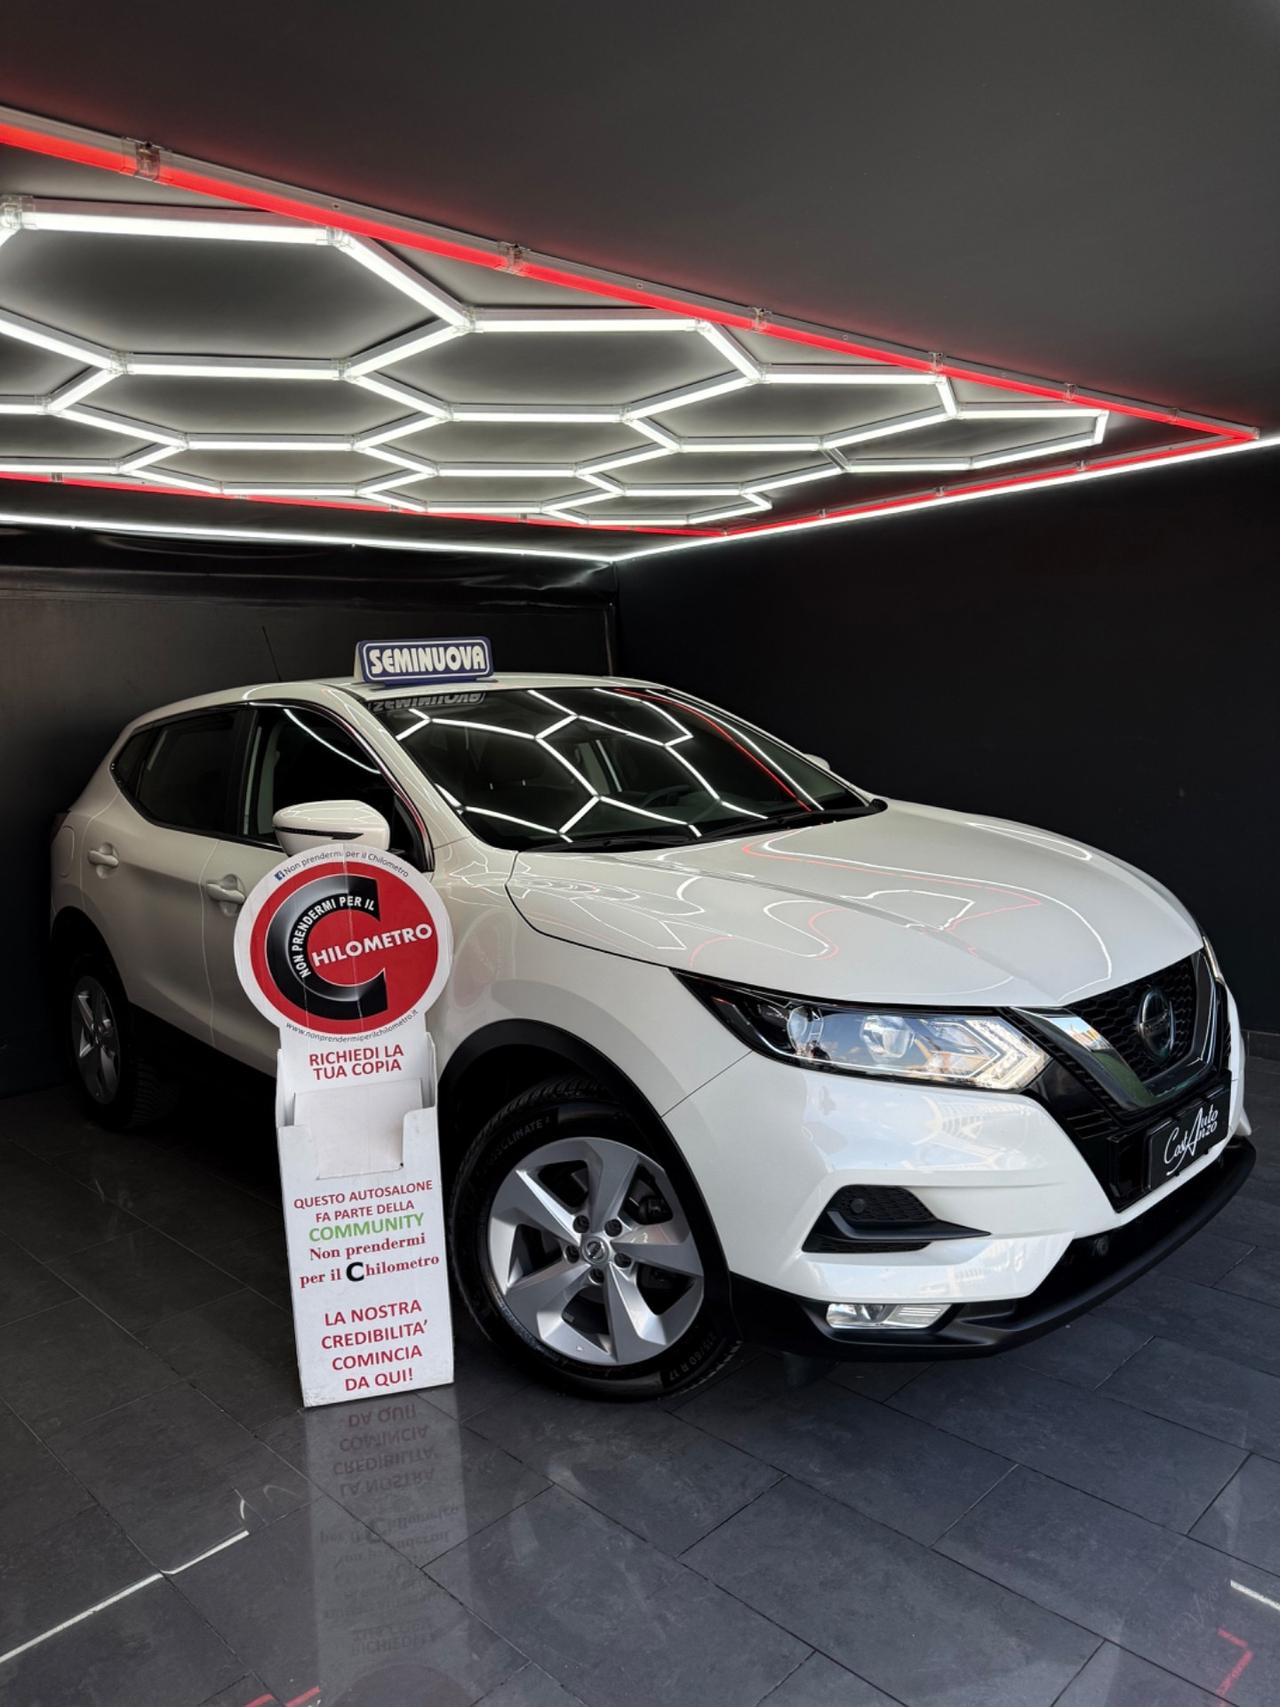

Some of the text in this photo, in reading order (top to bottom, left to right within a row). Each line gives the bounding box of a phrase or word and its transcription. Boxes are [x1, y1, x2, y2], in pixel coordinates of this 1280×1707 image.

[369, 646, 485, 674] SEMINUOVA
[284, 862, 301, 875] Non
[345, 851, 360, 859] per
[368, 853, 408, 877] Chilometro
[292, 896, 375, 978] NON PRENDERMI PER IL
[286, 1009, 419, 1043] www.nonprendermiperilchilometro.it
[309, 1044, 404, 1066] RICHIEDI LA
[313, 1059, 402, 1080] TUA COPIA
[294, 1180, 432, 1209] QUESTO AUTOSALONE
[316, 1200, 415, 1223] FA PARTE DELLA
[309, 1213, 424, 1242] COMMUNITY
[310, 1233, 426, 1260] Non prendermi
[299, 1255, 439, 1288] per il Chilometro
[324, 1299, 422, 1326] LA NOSTRA
[332, 1345, 422, 1370] COMINCIA
[345, 1368, 414, 1391] DA QUI!
